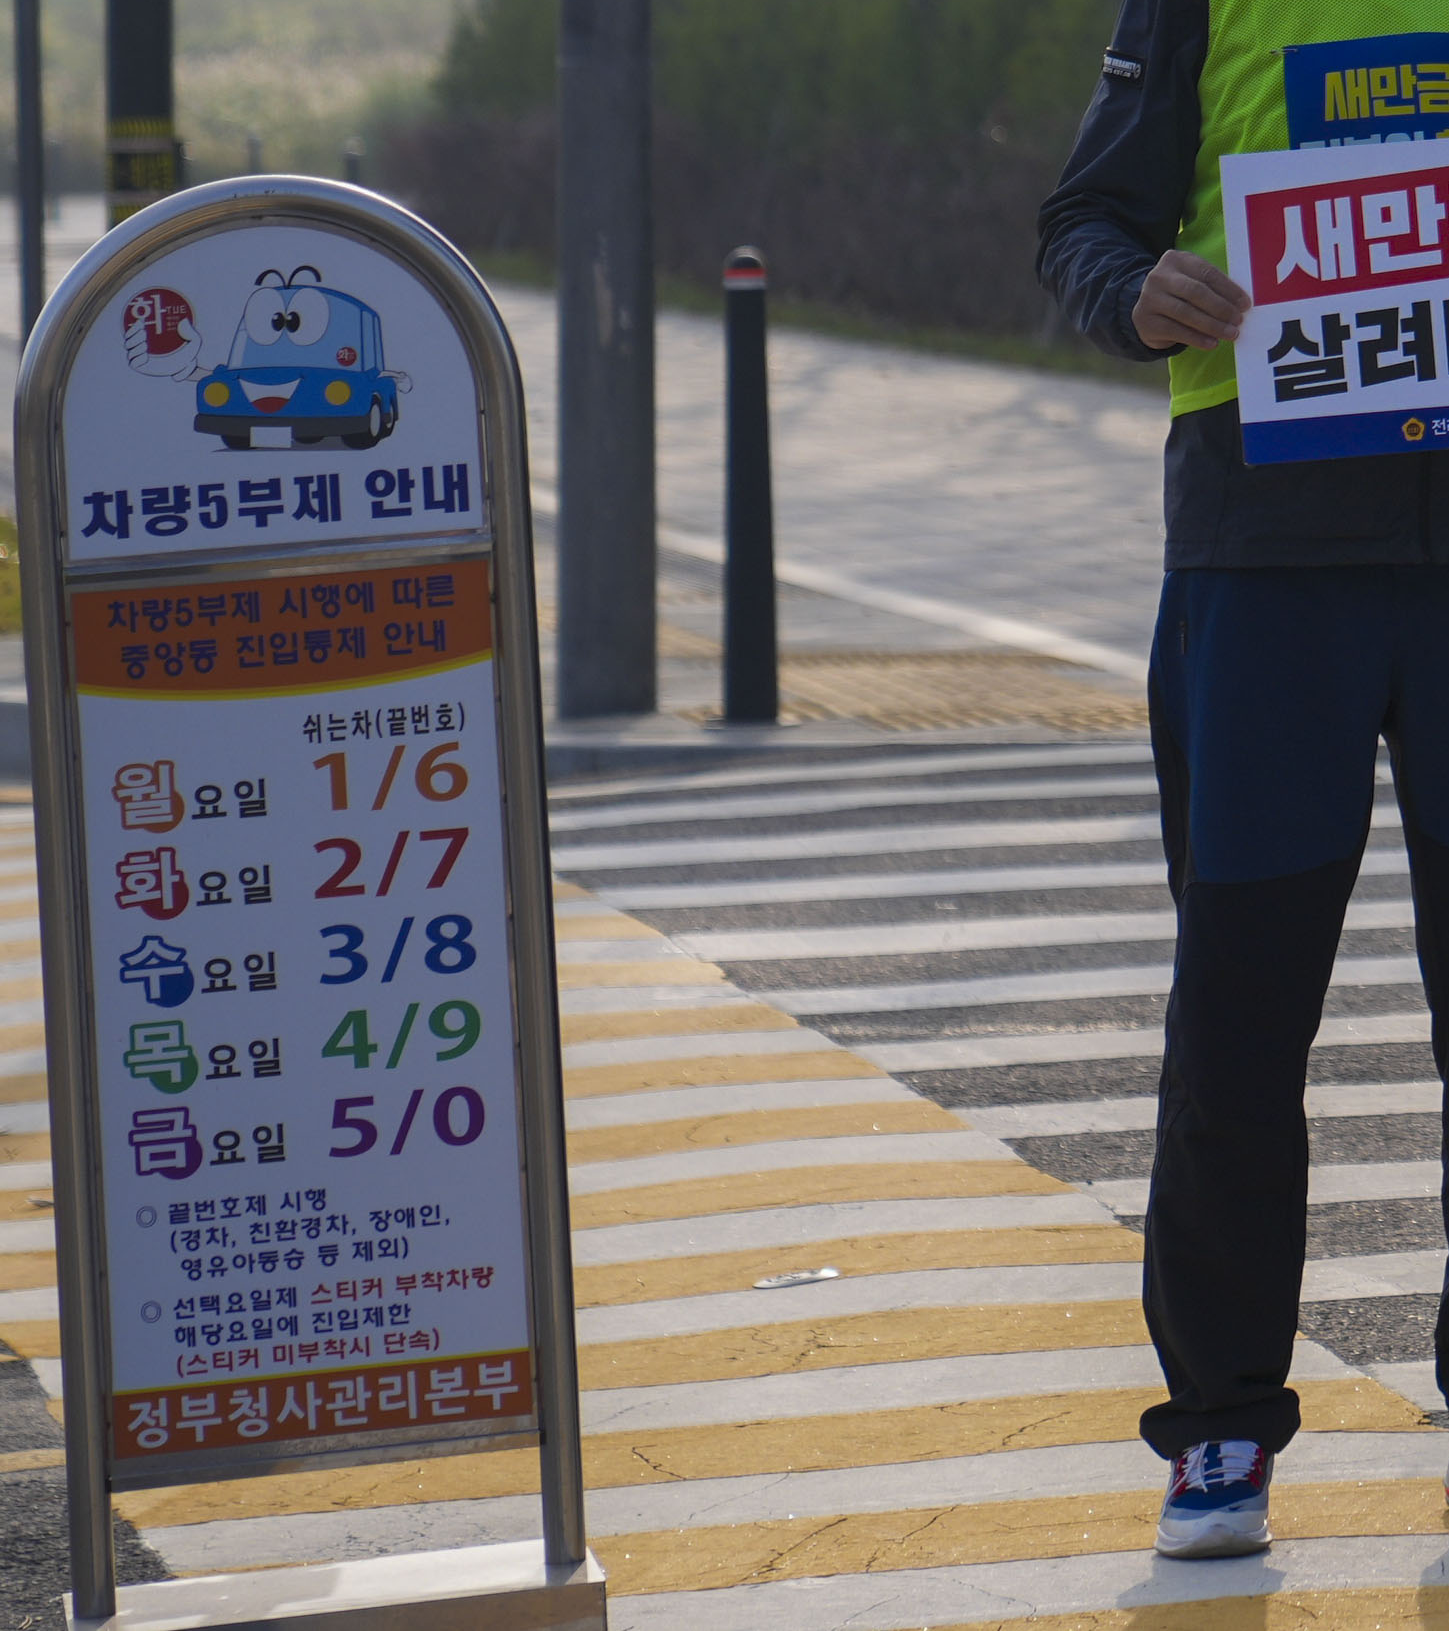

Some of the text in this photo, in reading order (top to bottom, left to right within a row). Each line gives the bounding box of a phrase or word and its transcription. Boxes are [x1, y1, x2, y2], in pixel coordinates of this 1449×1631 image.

[81, 464, 470, 540] 차량5부제 안내
[107, 574, 455, 633] 차량5부제 시행에 따른
[121, 619, 446, 679] 중앙동 진입통제 안내
[302, 701, 467, 744] 쉬는차(끝번호)
[111, 741, 468, 830] 월요일 1/6
[115, 827, 470, 911] 화요일 2/7
[119, 914, 477, 1003] 수요일 3/8
[124, 999, 481, 1084] 목요일 4/9
[129, 1085, 485, 1177] 금요일 5/0
[168, 1188, 327, 1225] 끝번호제 시행
[170, 1203, 450, 1254] (경차, 친환경차, 장애인,
[181, 1235, 409, 1282] 영유아동승 등 제외)
[173, 1266, 495, 1320] 선택요일제 스티커 부착차량
[174, 1303, 412, 1349] 해당요일에 진입제한
[176, 1327, 441, 1379] (스티커 미부착시 단속)
[127, 1361, 519, 1450] 정부청사관리본부
